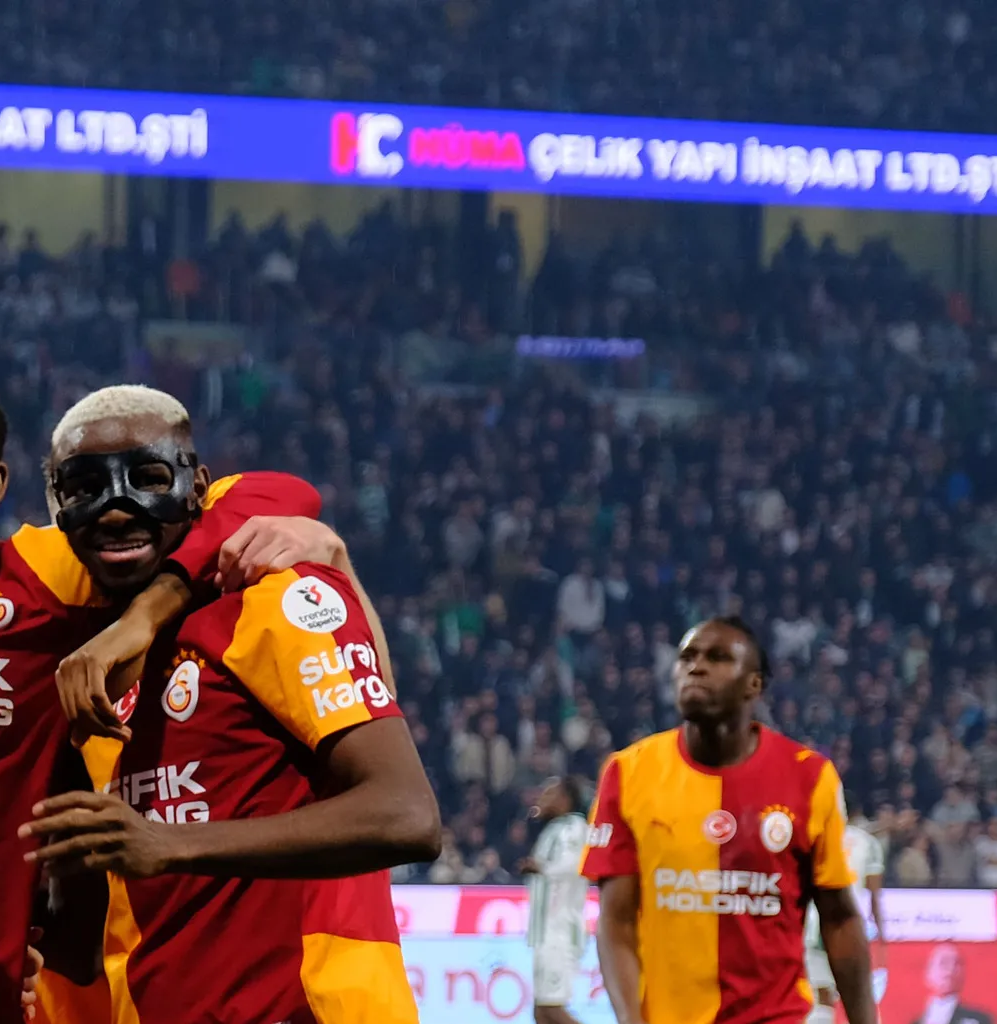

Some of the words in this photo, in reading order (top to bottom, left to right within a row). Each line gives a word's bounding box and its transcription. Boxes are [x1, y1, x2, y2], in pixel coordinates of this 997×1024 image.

[646, 138, 737, 185] YAPI
[884, 150, 997, 204] LTD.Ş
[312, 675, 394, 718] karg
